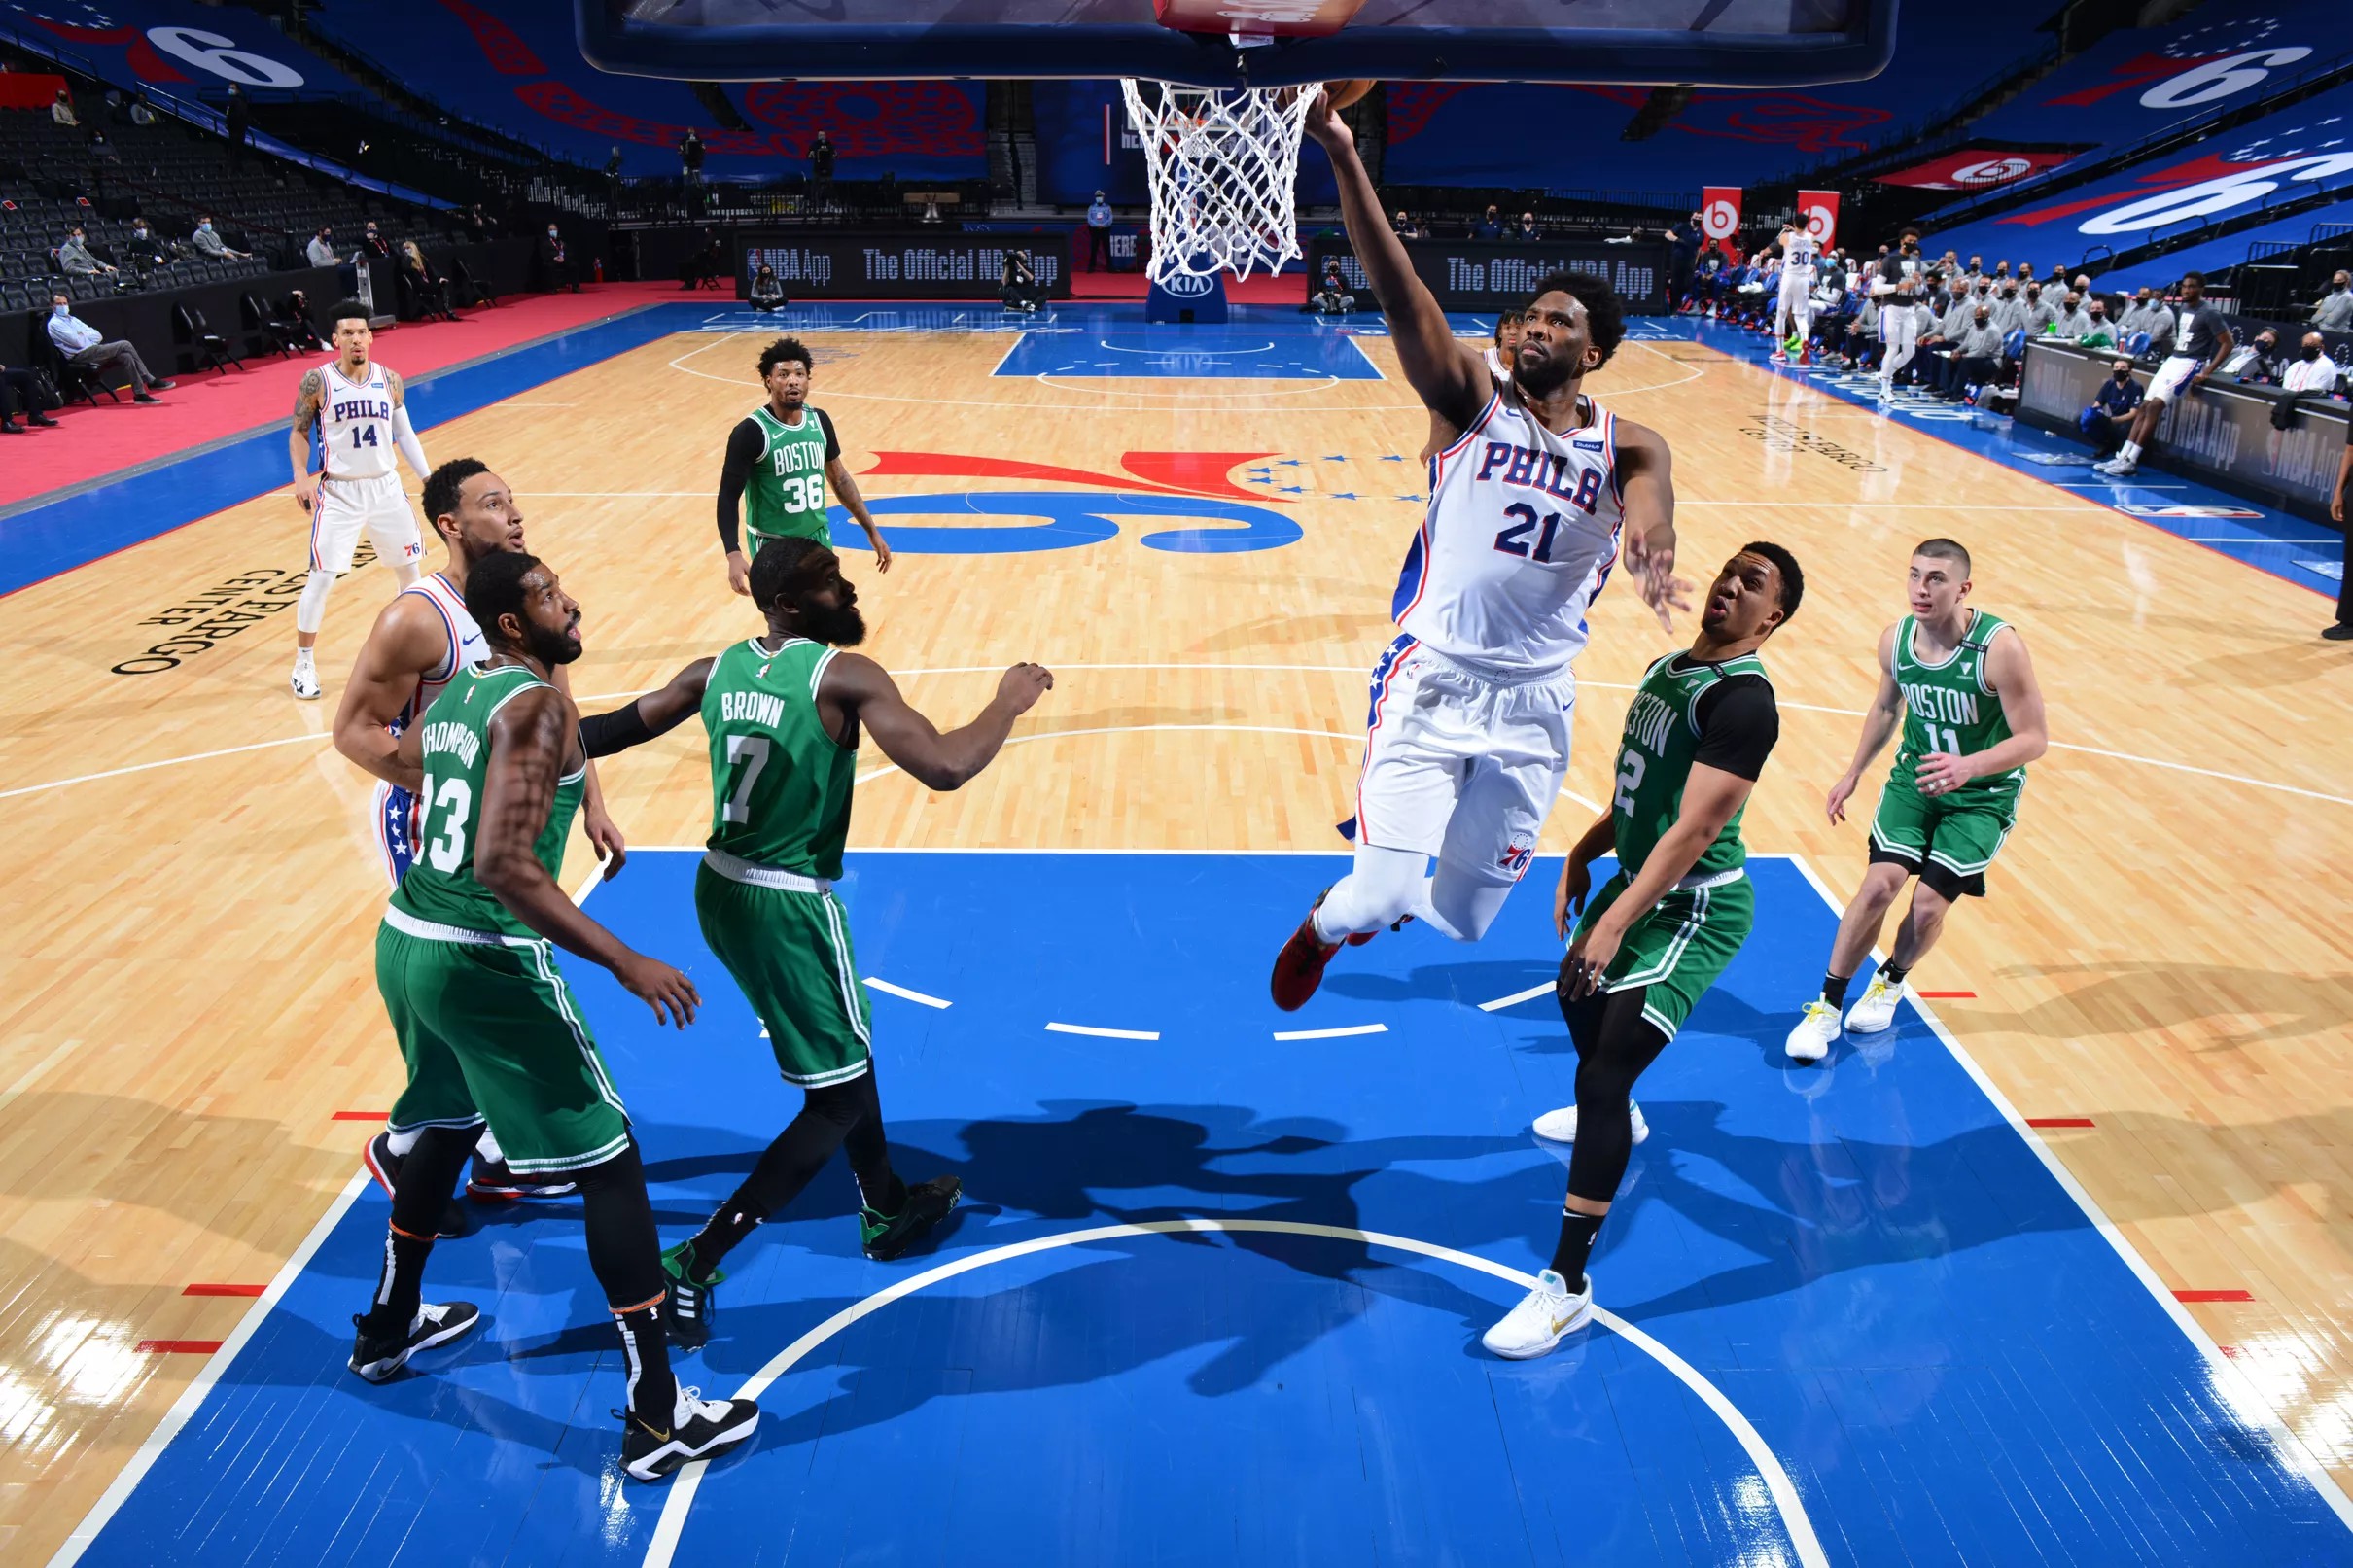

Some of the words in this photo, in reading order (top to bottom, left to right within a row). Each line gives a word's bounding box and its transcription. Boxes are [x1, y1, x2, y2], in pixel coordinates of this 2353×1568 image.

[764, 249, 800, 281] NBA
[803, 250, 831, 286] App
[863, 249, 898, 280] The
[904, 249, 973, 280] Official
[979, 249, 1019, 280] NB
[1791, 251, 1809, 266] 30
[1171, 278, 1205, 292] KIA
[1447, 258, 1485, 291] The
[1614, 261, 1653, 300] App
[333, 400, 390, 423] PHILA
[351, 424, 378, 449] 14
[2207, 406, 2241, 471] App
[773, 441, 825, 476] BOSTON
[782, 473, 824, 514] 36
[1476, 441, 1602, 516] PHILA
[404, 542, 421, 557] 76
[1493, 501, 1562, 564] 21
[137, 569, 287, 626] CENTER
[721, 691, 786, 729] BROWN
[1923, 722, 1961, 757] 11
[722, 734, 771, 825] 7
[1499, 843, 1531, 871] 76
